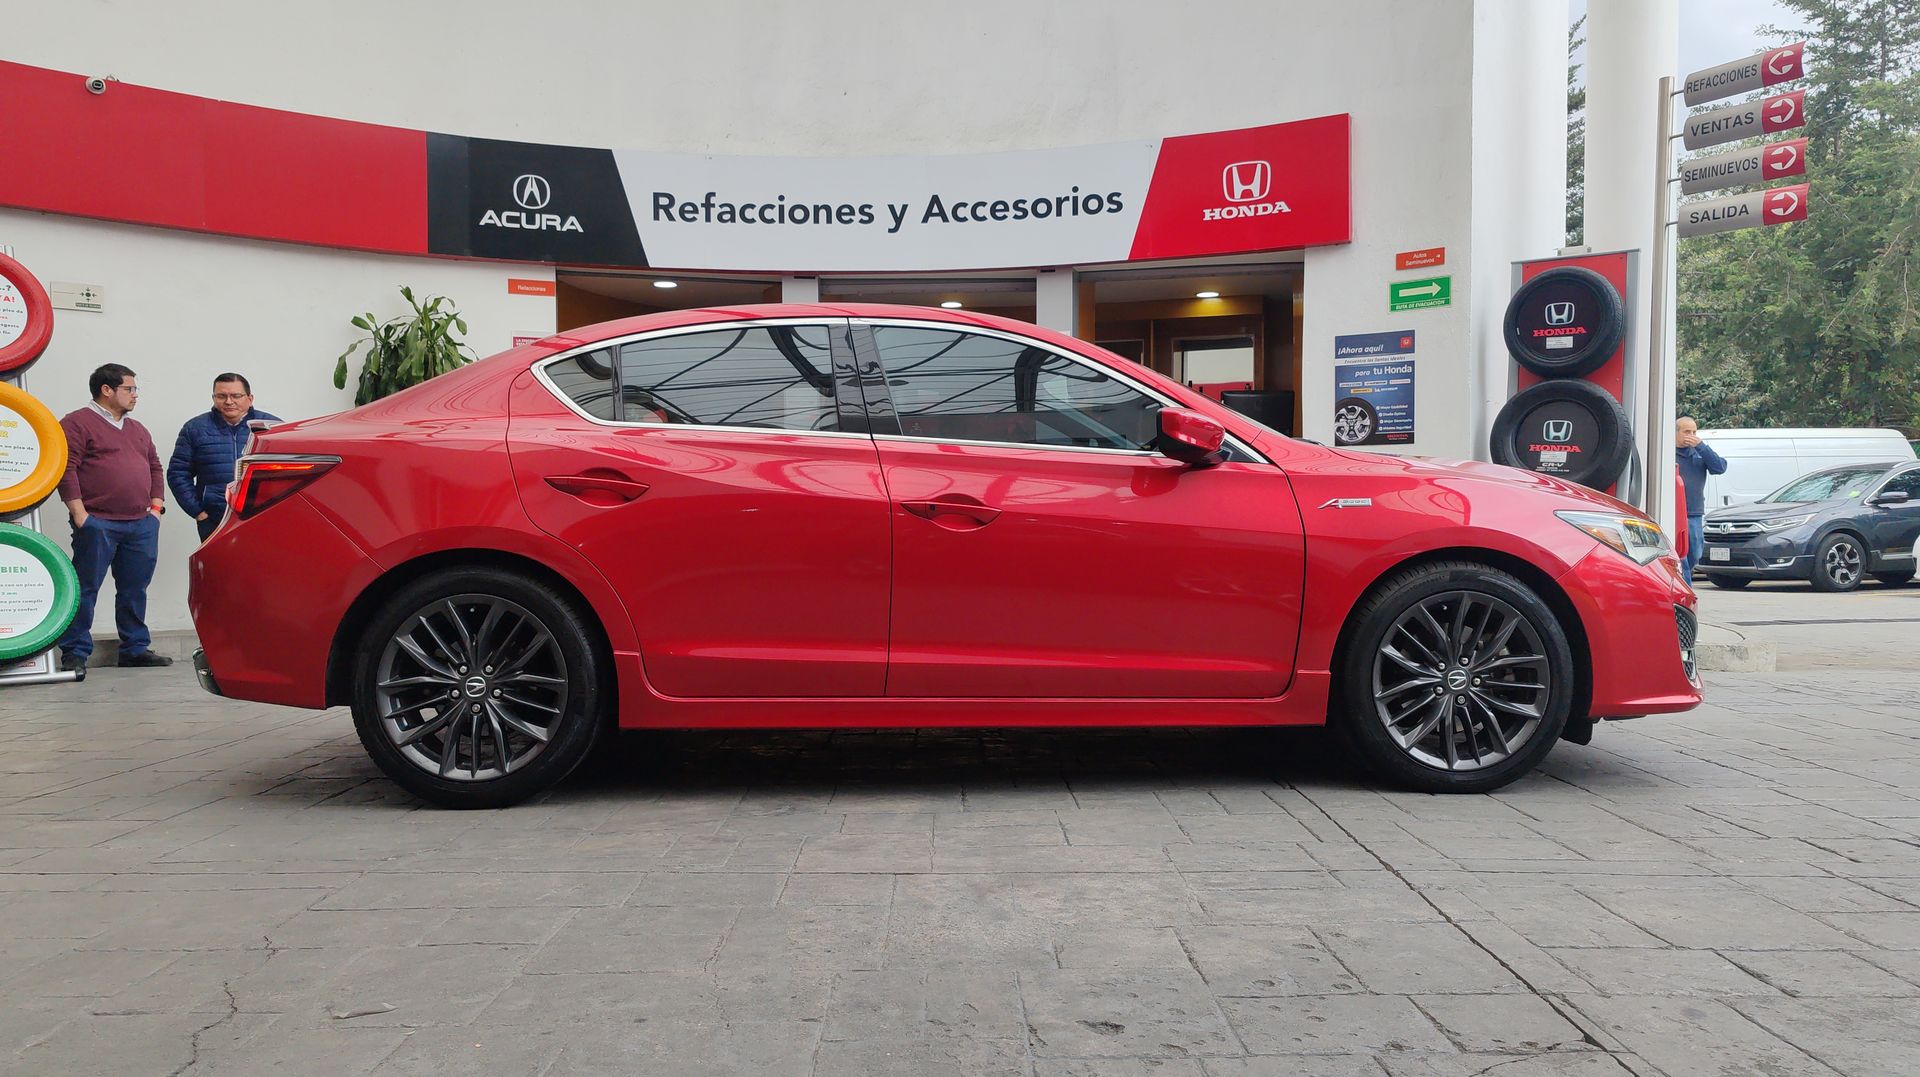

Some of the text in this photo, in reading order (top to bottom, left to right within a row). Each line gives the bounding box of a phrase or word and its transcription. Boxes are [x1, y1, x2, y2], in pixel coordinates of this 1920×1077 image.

[1686, 64, 1758, 94] REFACCIONES
[1690, 112, 1754, 137] VENTAS
[1684, 157, 1759, 182] SEMINUEVOS
[652, 186, 1124, 233] Refacciones y Accesorios
[1203, 201, 1292, 221] HONDA
[1689, 204, 1749, 224] SALIDA
[478, 209, 584, 233] ACURA
[1405, 258, 1435, 266] Seminuevos
[517, 284, 546, 292] Refacciones
[1532, 327, 1587, 337] HONDA
[1355, 364, 1412, 378] para tu Honda
[1528, 444, 1582, 453] HONDA
